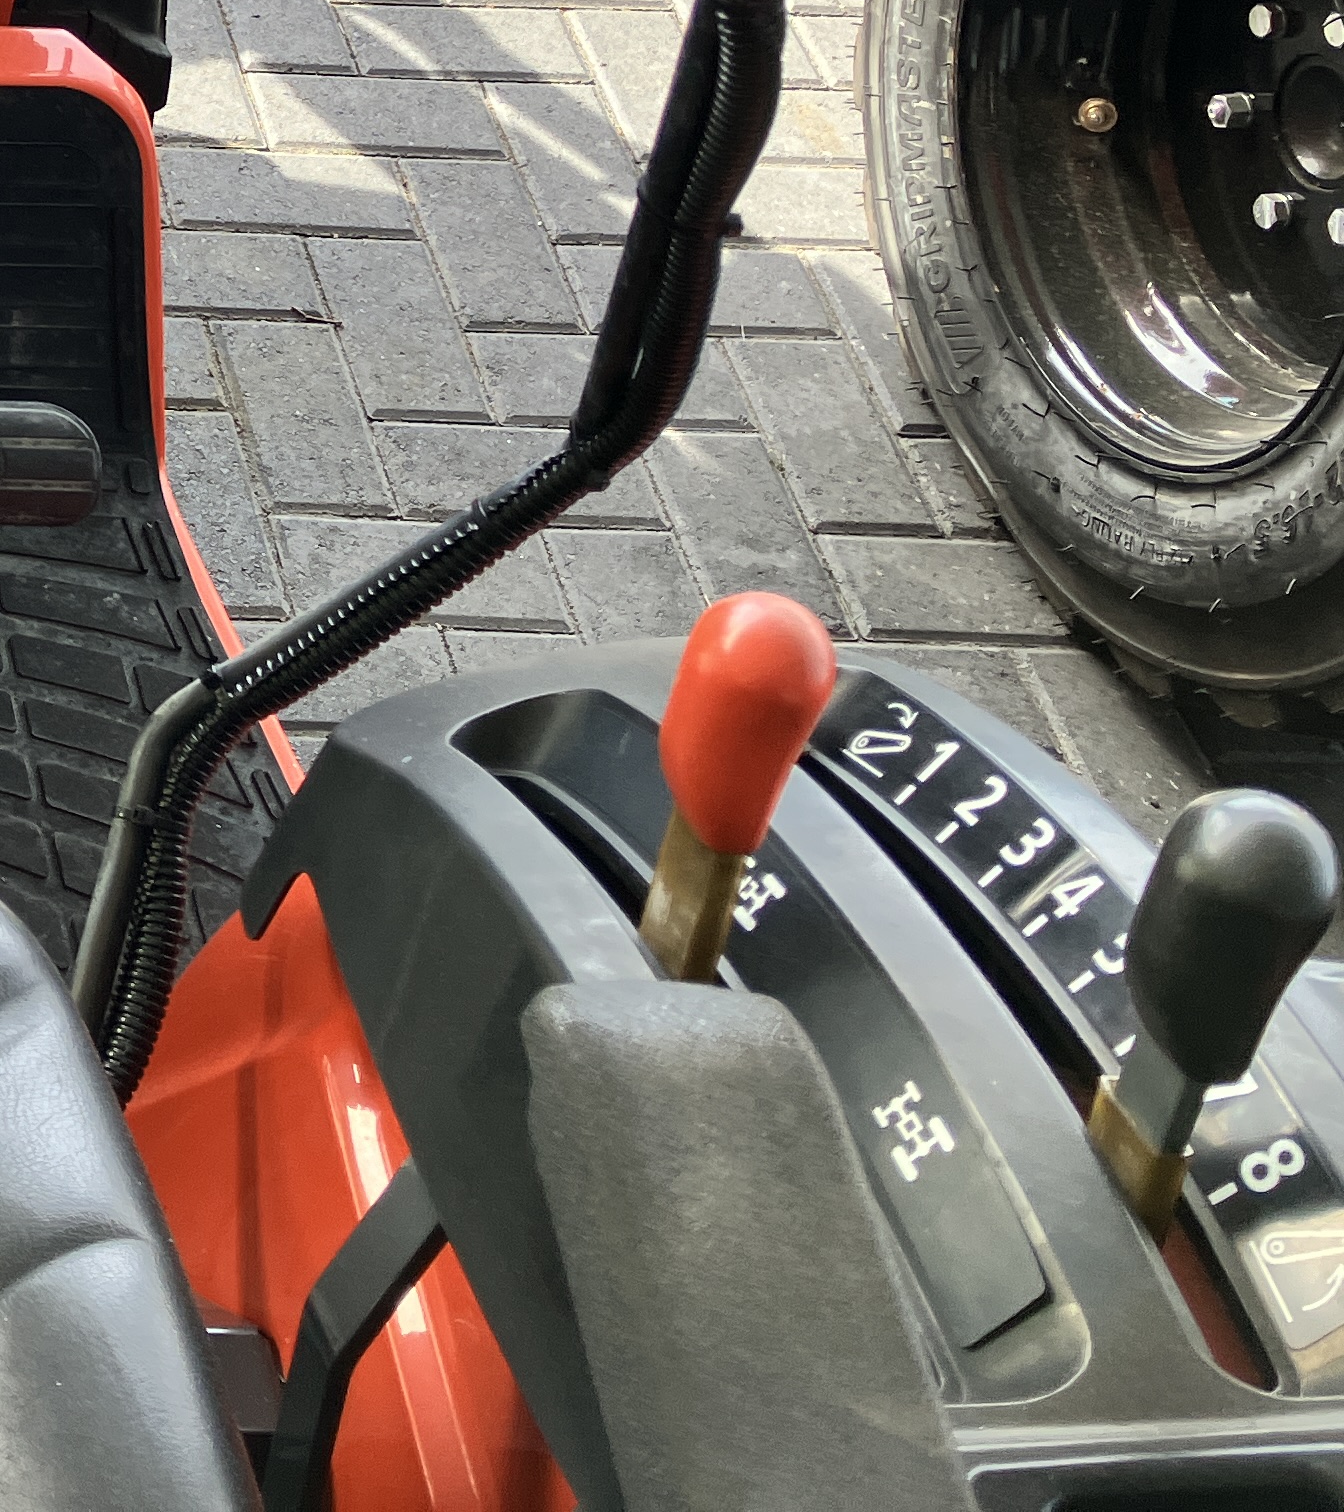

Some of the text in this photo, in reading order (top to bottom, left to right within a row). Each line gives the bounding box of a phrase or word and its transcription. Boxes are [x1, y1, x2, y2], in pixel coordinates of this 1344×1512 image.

[916, 741, 960, 782] 1
[954, 774, 1008, 827] 2
[999, 817, 1055, 866] 3
[1050, 875, 1105, 919] 4
[1240, 1138, 1305, 1193] 8
